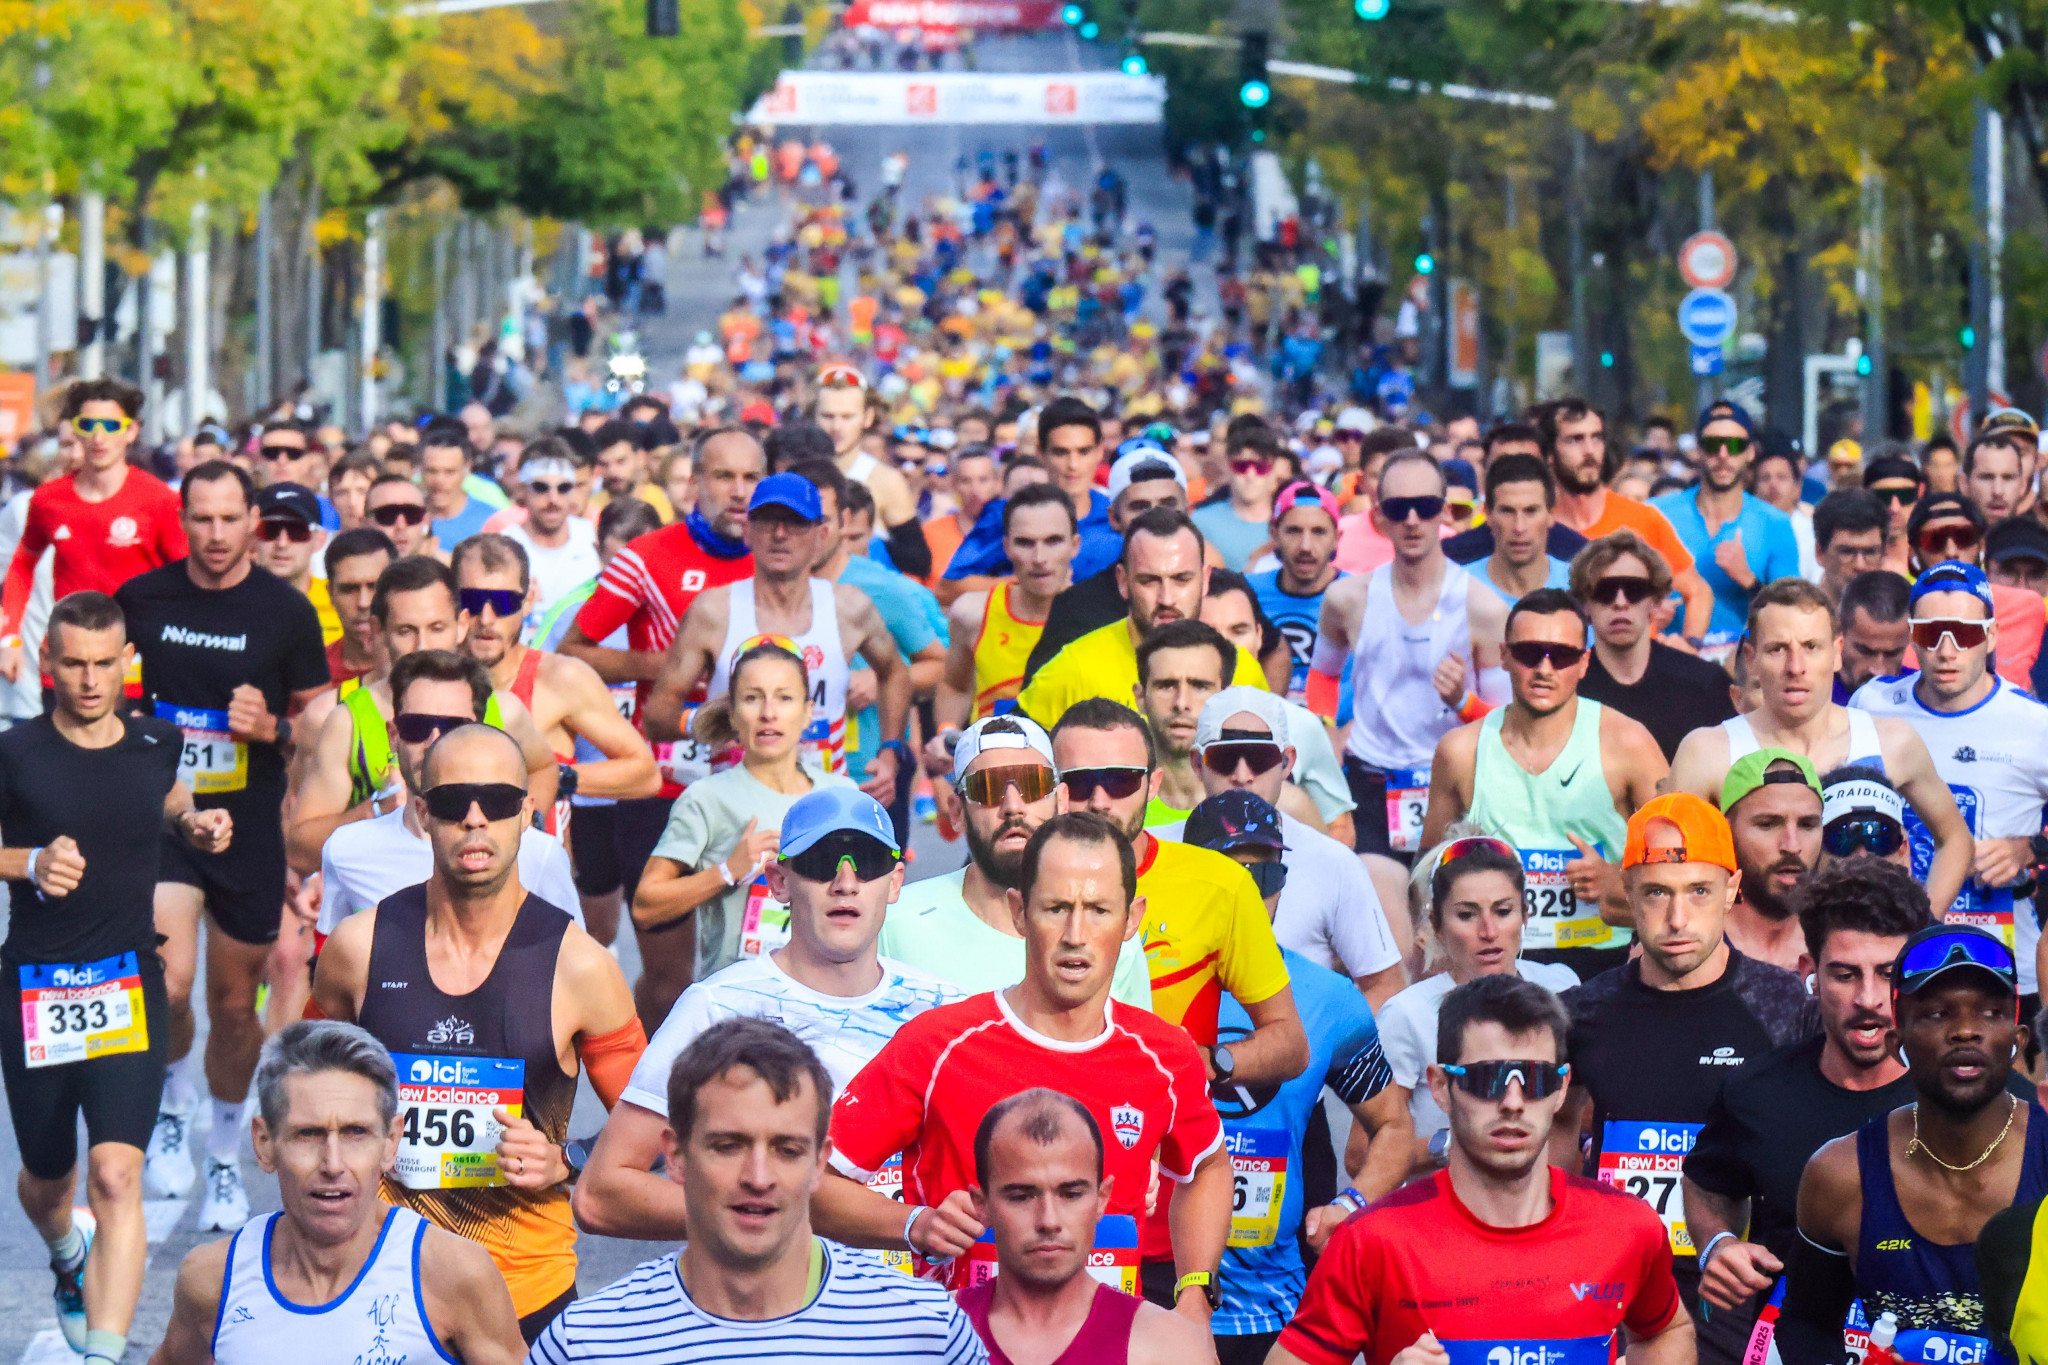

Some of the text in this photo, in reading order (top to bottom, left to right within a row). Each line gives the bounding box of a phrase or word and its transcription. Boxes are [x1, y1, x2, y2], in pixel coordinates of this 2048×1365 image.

[381, 981, 409, 989] START
[48, 1000, 108, 1035] 333
[1713, 1057, 1745, 1066] SPORT
[432, 1060, 462, 1084] ici
[399, 1086, 500, 1105] ew balance
[403, 1106, 476, 1148] 456
[1660, 1128, 1689, 1152] ici
[1619, 1156, 1653, 1170] new
[1876, 1239, 1912, 1250] 42K
[1570, 1283, 1626, 1301] VPLUS
[1753, 1325, 1770, 1353] 2025
[1513, 1345, 1546, 1365] ici
[1949, 1338, 1982, 1364] ici
